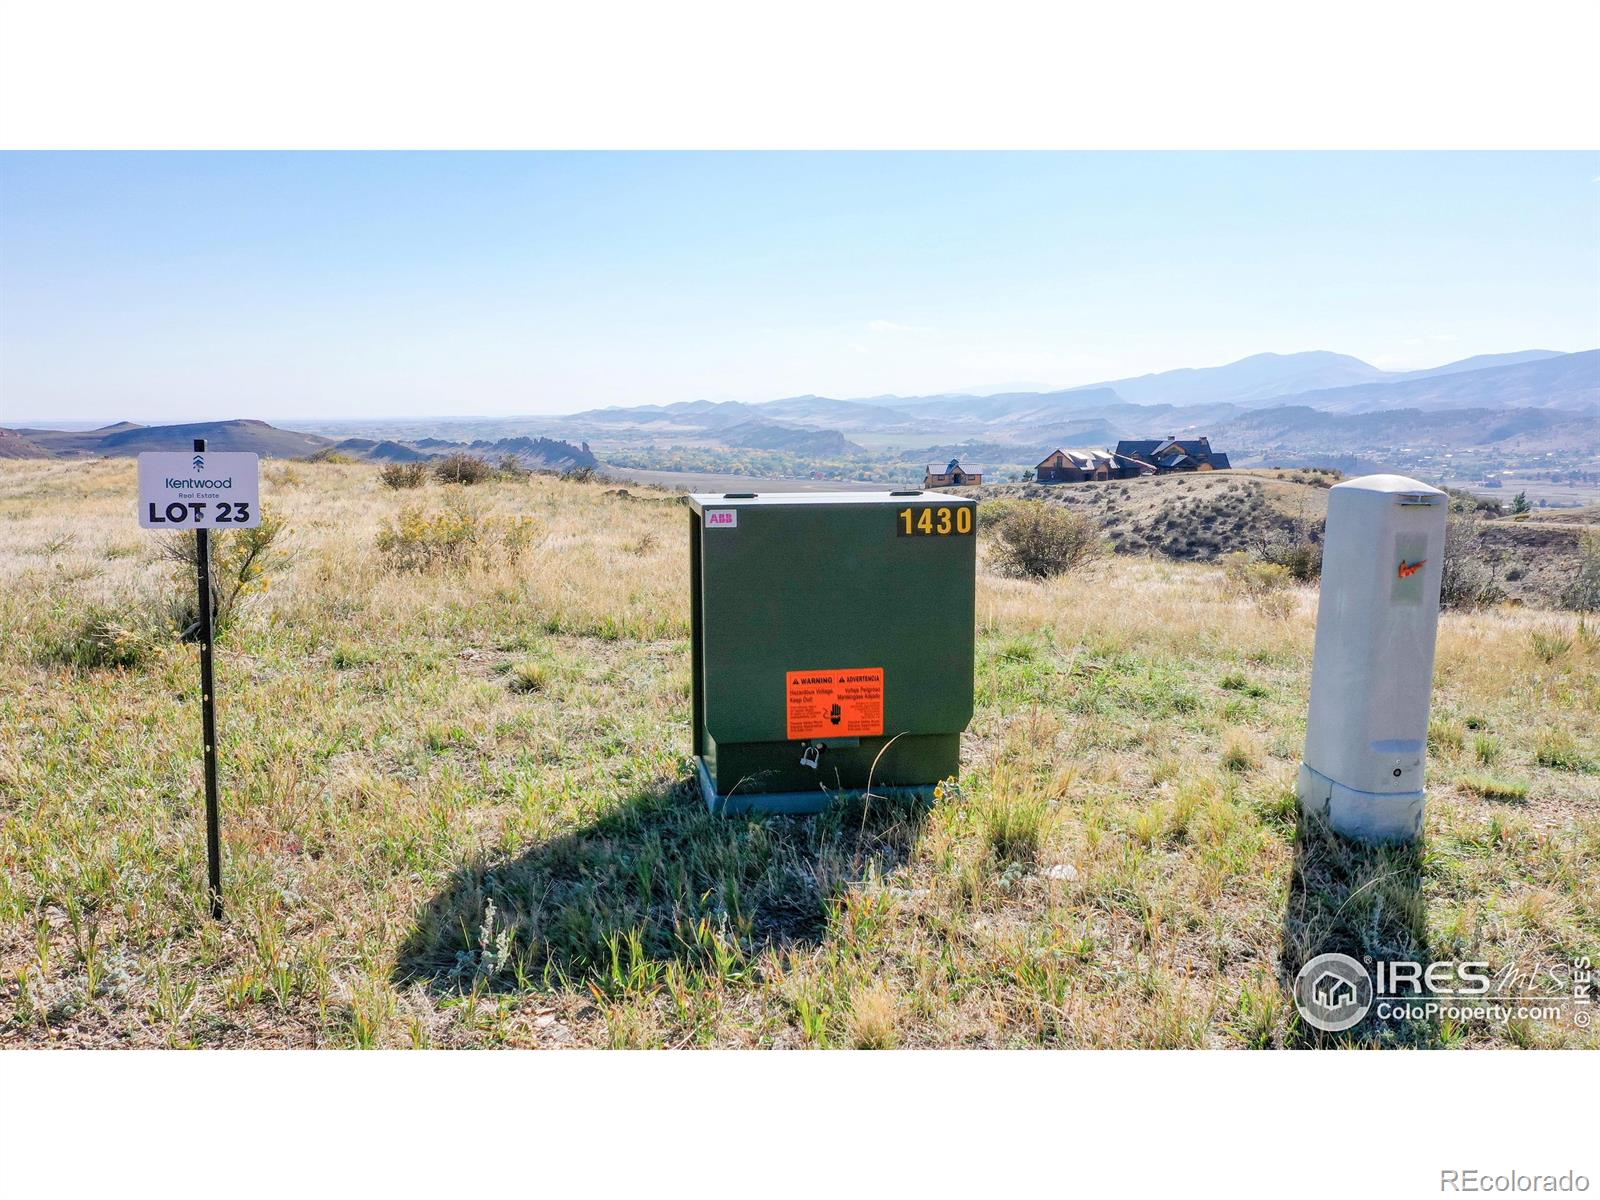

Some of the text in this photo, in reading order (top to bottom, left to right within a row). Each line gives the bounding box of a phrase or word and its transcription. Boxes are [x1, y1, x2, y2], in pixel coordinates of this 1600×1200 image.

[165, 477, 232, 489] Kentwood
[149, 502, 250, 523] LOT 23
[709, 513, 733, 525] ABB
[900, 506, 972, 535] 1430
[846, 675, 880, 683] ADVERTENCIA
